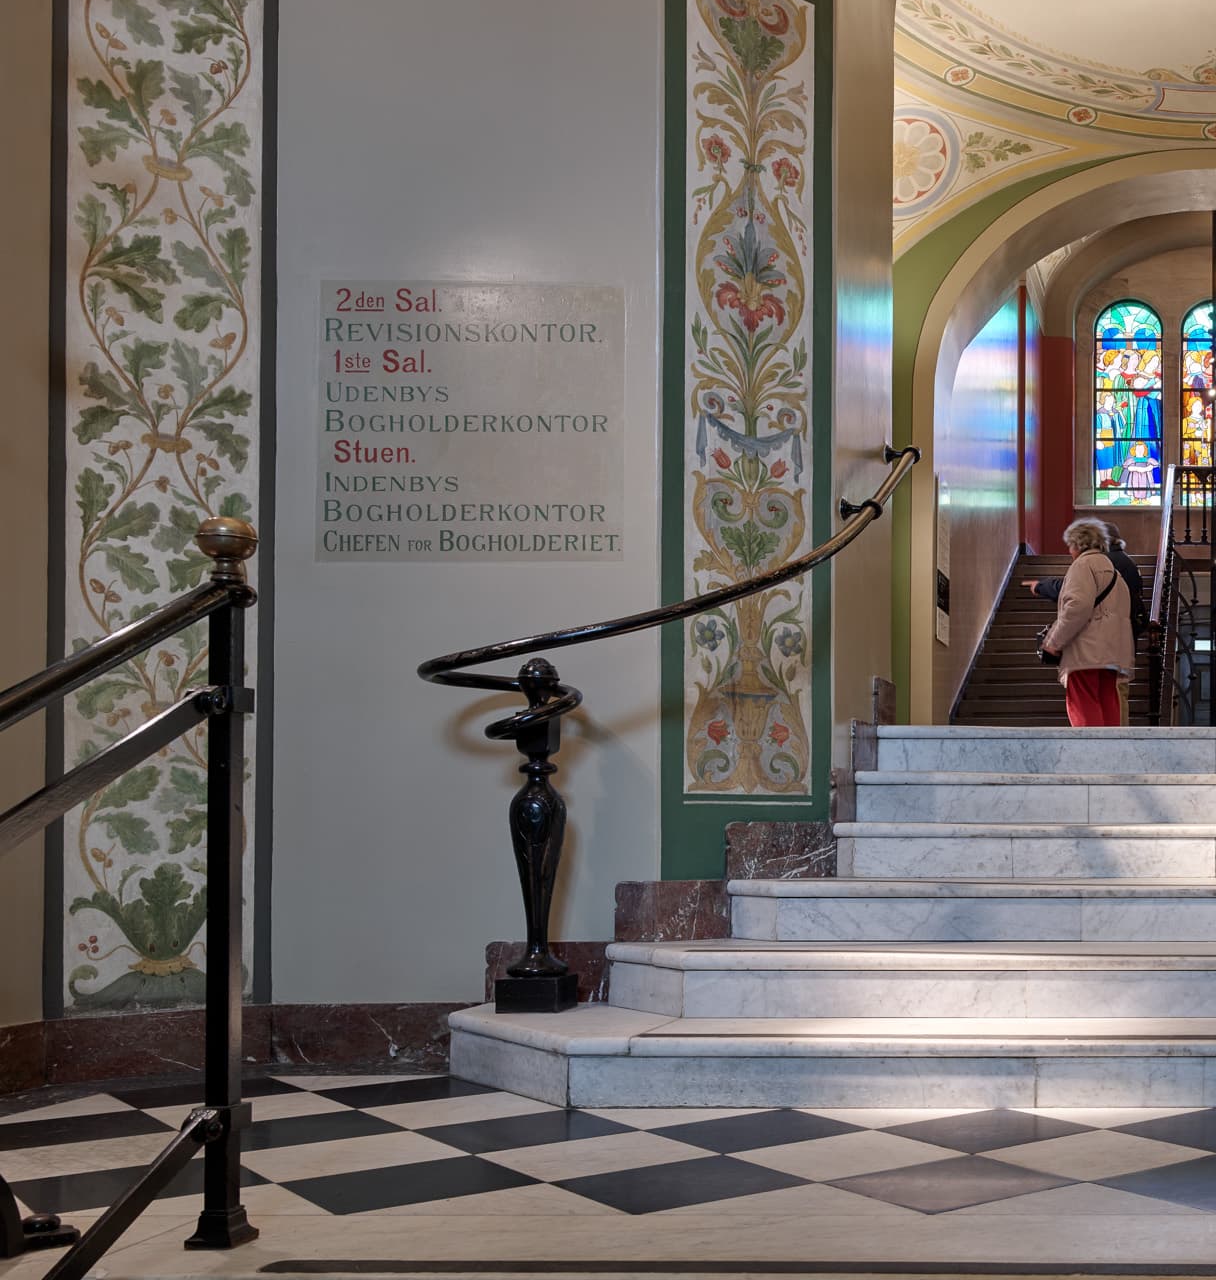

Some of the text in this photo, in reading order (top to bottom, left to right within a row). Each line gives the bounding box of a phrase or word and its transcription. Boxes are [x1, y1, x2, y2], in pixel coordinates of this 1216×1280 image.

[336, 288, 442, 312] 2den Sal.
[325, 318, 602, 342] REVISIONSKONTOR.
[335, 349, 432, 373] 1ste Sal.
[327, 382, 449, 403] UDENBYS
[325, 410, 608, 433] BOGHOLDERKONTOR
[334, 440, 416, 464] Stuen.
[325, 472, 459, 492] INDENBYS
[323, 500, 605, 522] BOGHOLDERKONTOR
[323, 529, 621, 552] CHEFEN FOR BOGHOLDERIET.
